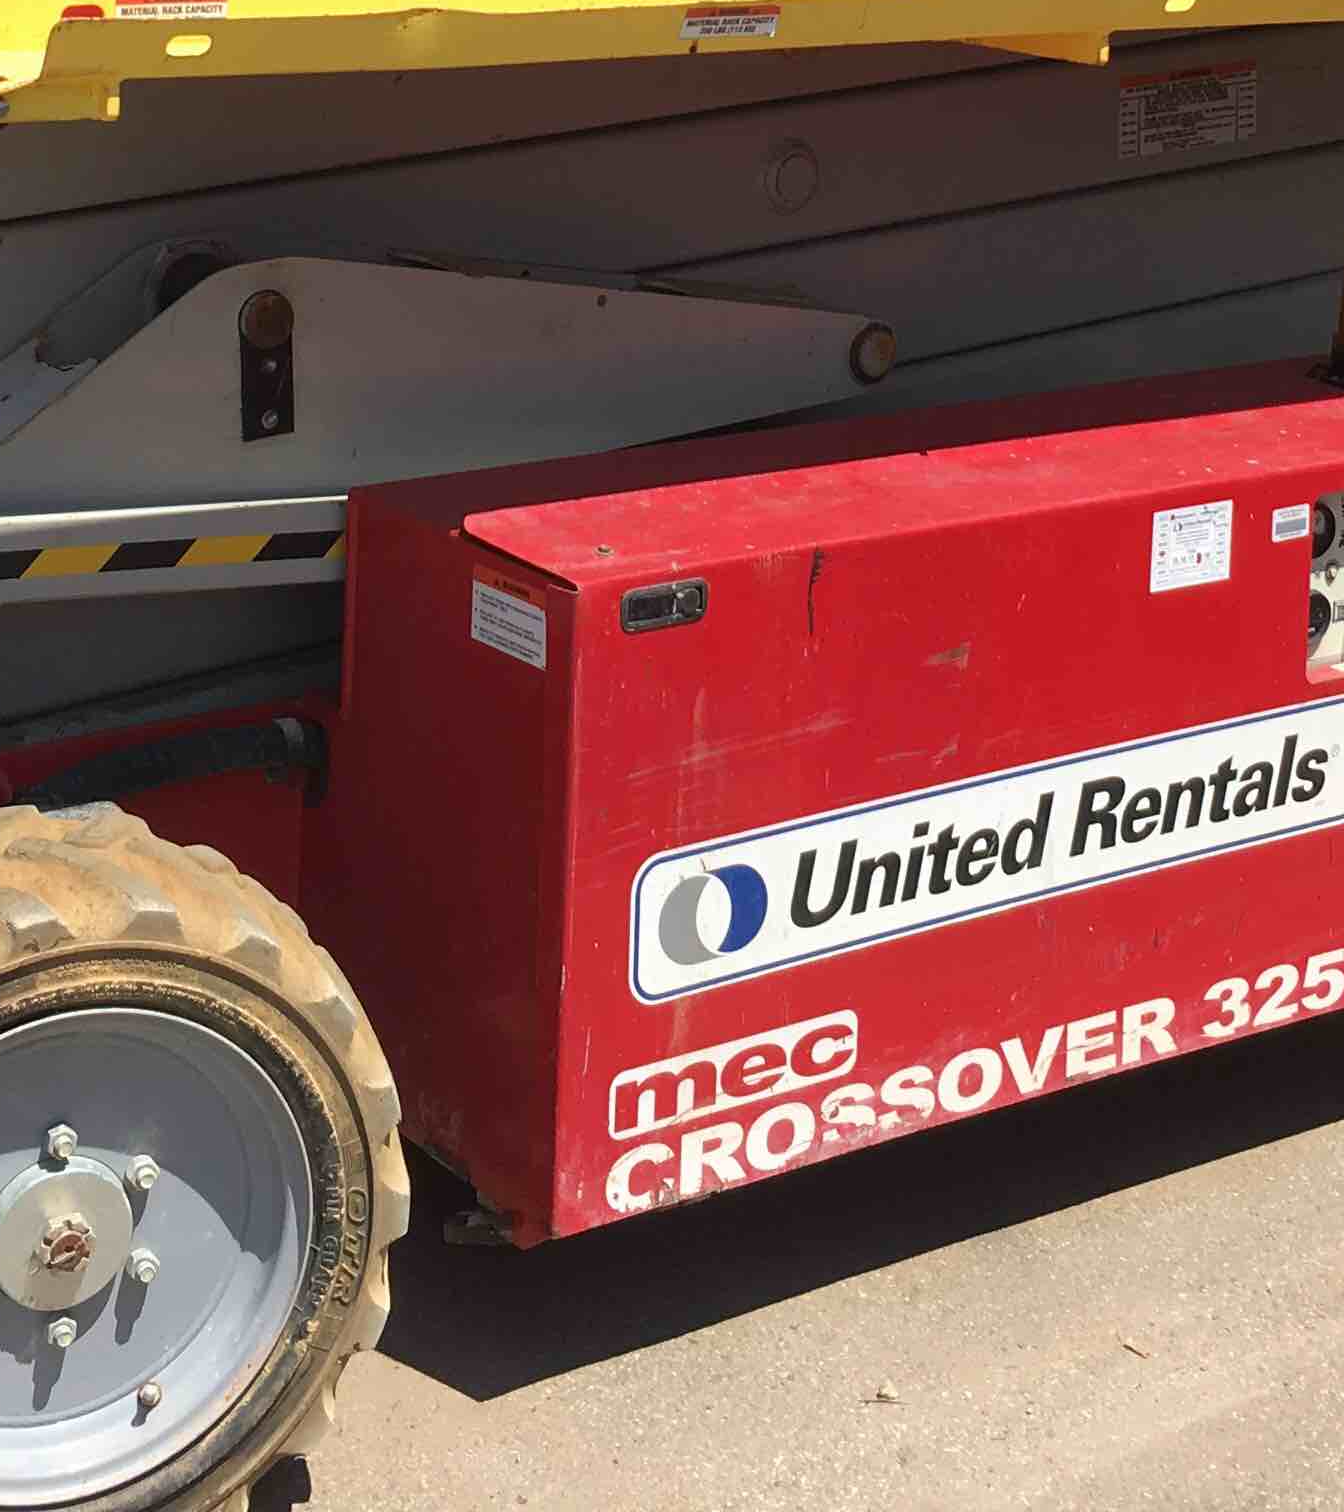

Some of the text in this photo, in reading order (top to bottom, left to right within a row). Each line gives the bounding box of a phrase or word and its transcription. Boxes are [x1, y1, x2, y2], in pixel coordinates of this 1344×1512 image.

[185, 4, 223, 14] CAPACITY
[790, 733, 1329, 928] United Rentals
[605, 996, 1177, 1214] CROSSOVER
